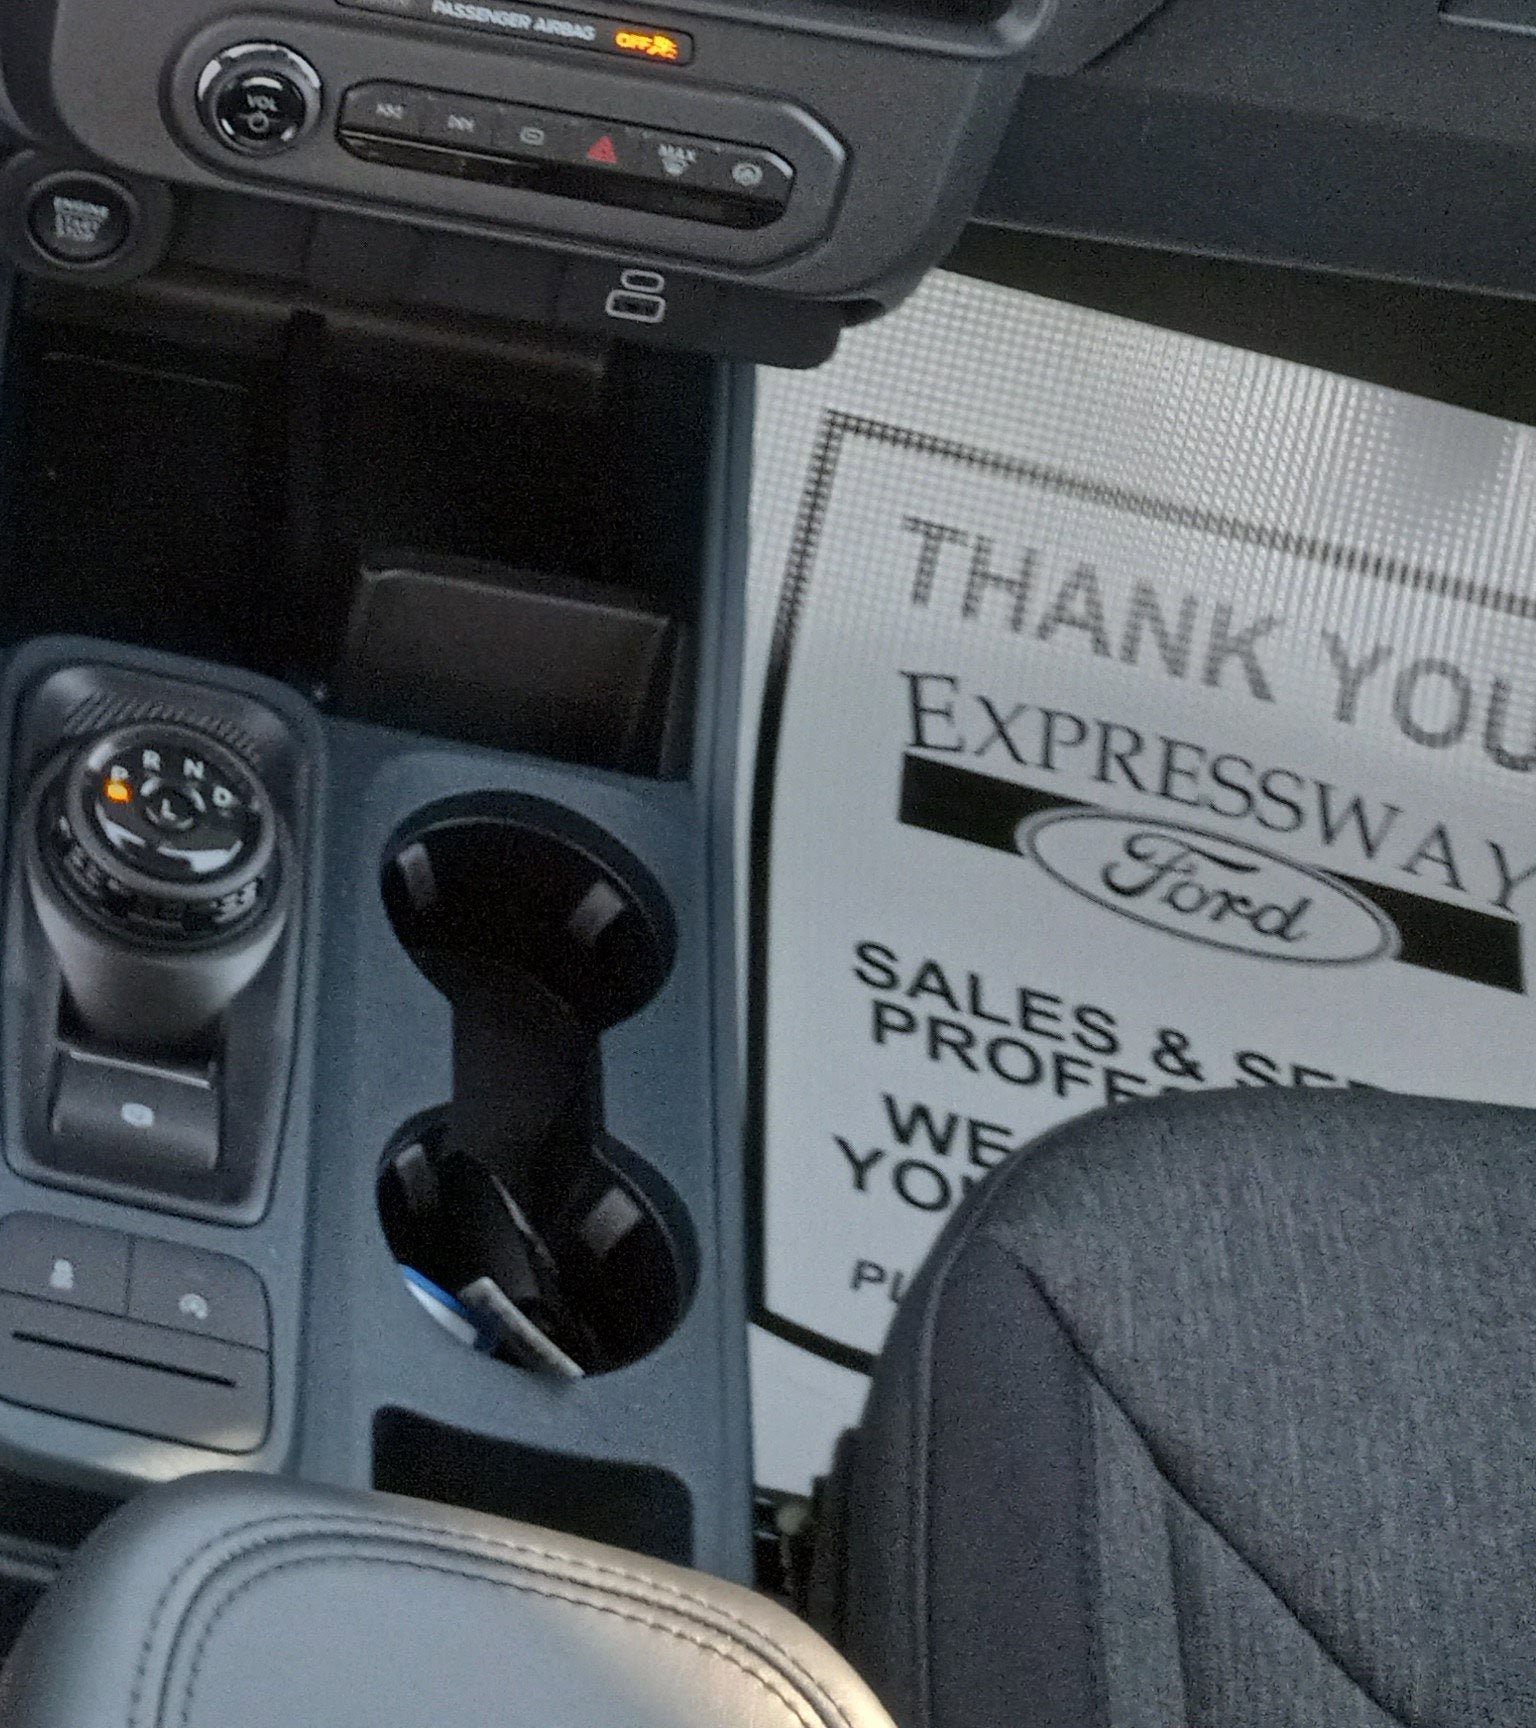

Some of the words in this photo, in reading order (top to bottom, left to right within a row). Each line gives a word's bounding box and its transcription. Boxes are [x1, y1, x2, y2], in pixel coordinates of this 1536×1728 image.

[533, 17, 597, 42] AIRBAG
[614, 31, 653, 51] OFF
[902, 514, 1286, 703] THANK
[901, 670, 1536, 915] EXPRESSWAY
[1100, 830, 1314, 945] Ford
[852, 939, 1122, 1057] SALES
[1151, 1026, 1206, 1083] &
[882, 1092, 1015, 1171] WE
